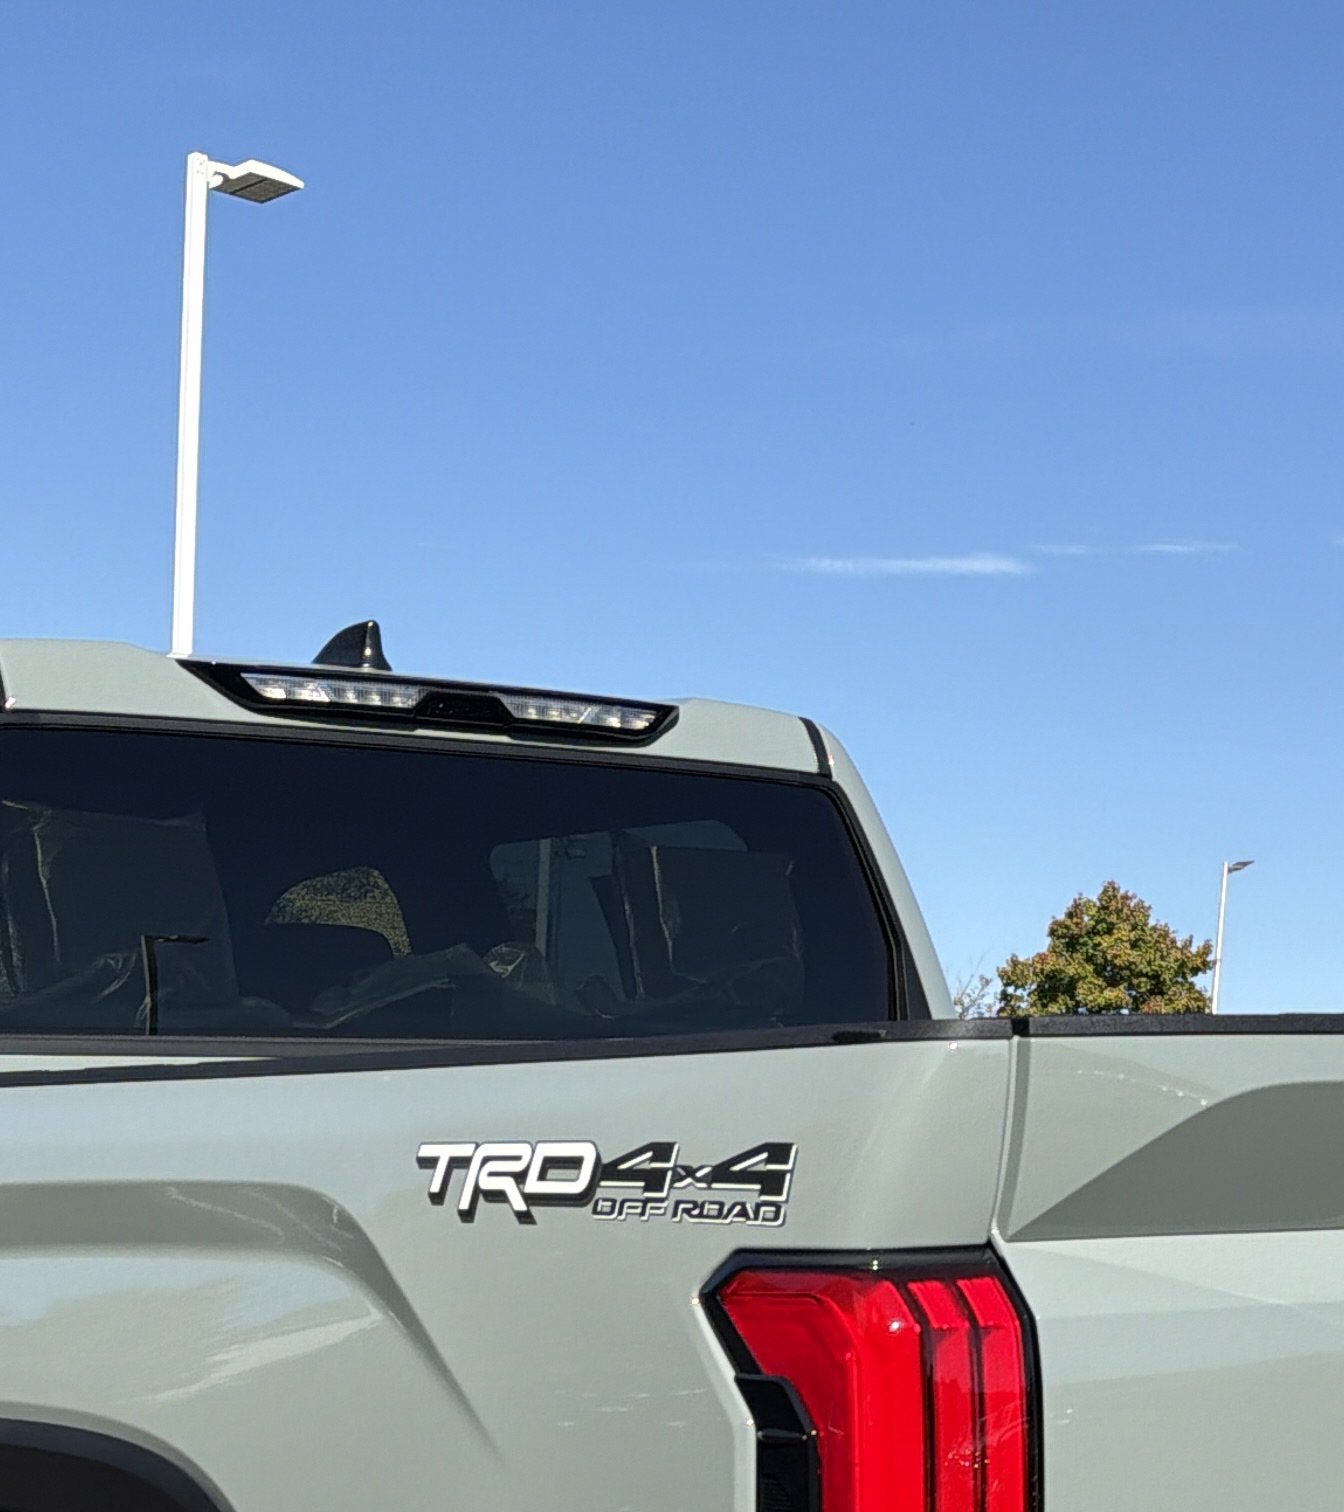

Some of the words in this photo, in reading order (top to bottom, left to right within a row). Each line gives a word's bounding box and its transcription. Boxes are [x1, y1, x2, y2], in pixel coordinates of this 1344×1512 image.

[416, 1141, 602, 1226] TRD
[592, 1198, 666, 1221] OFF
[671, 1199, 787, 1227] ROAD
